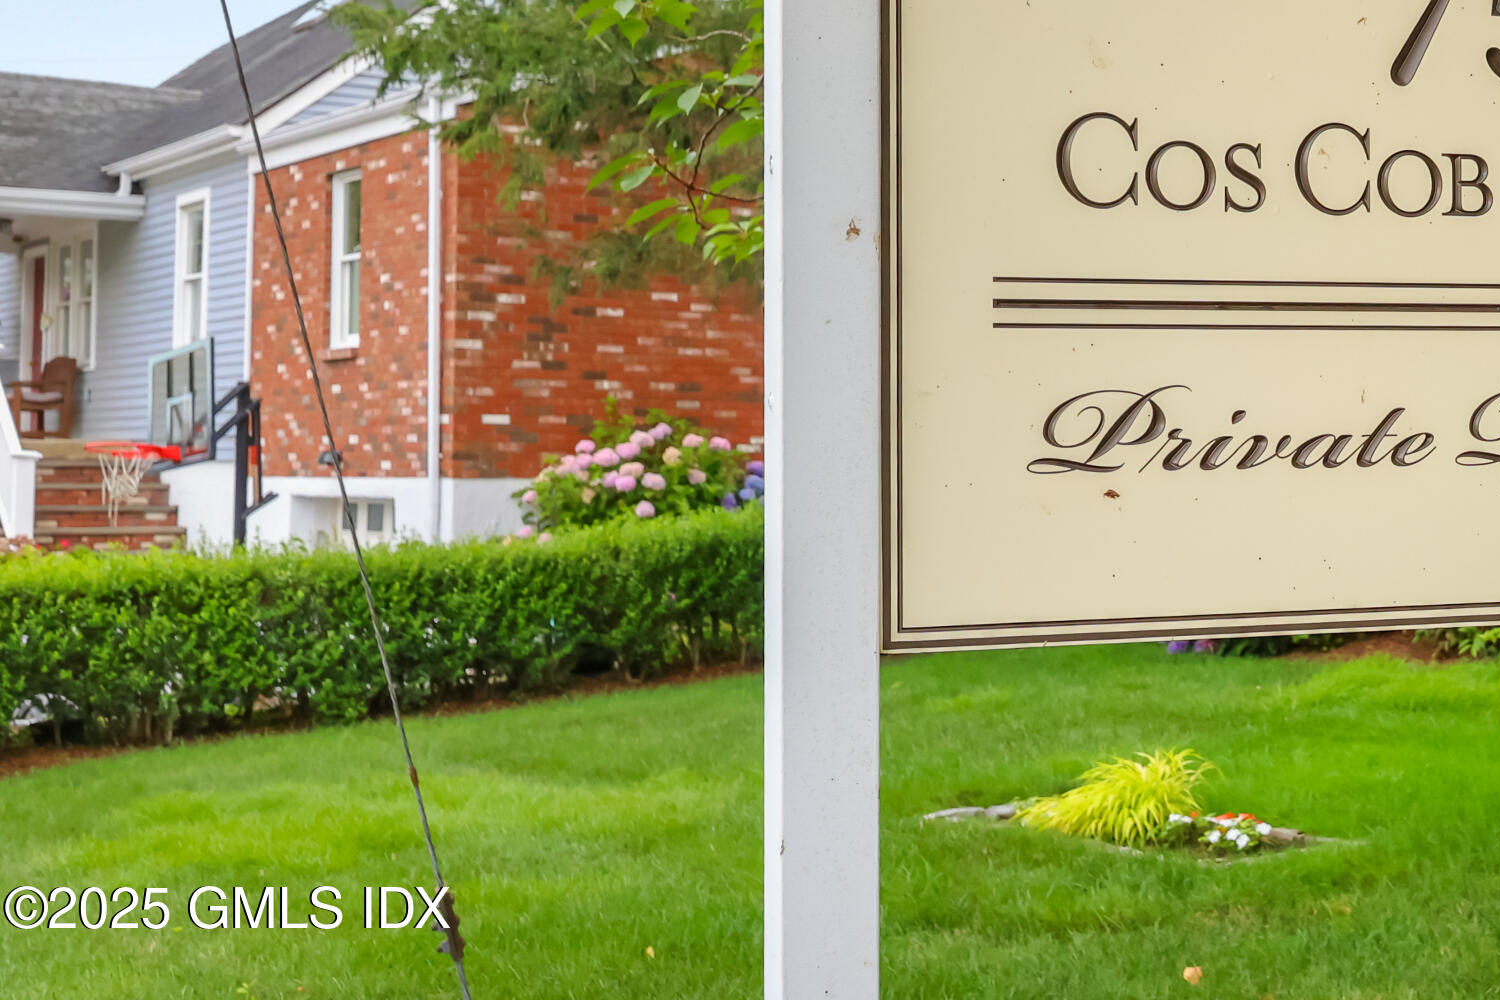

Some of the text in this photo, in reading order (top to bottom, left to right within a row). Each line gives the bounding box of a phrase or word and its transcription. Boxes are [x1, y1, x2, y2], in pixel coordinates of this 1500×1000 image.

[1055, 111, 1266, 213] COS
[1294, 122, 1493, 218] COB
[1026, 383, 1436, 475] Private
